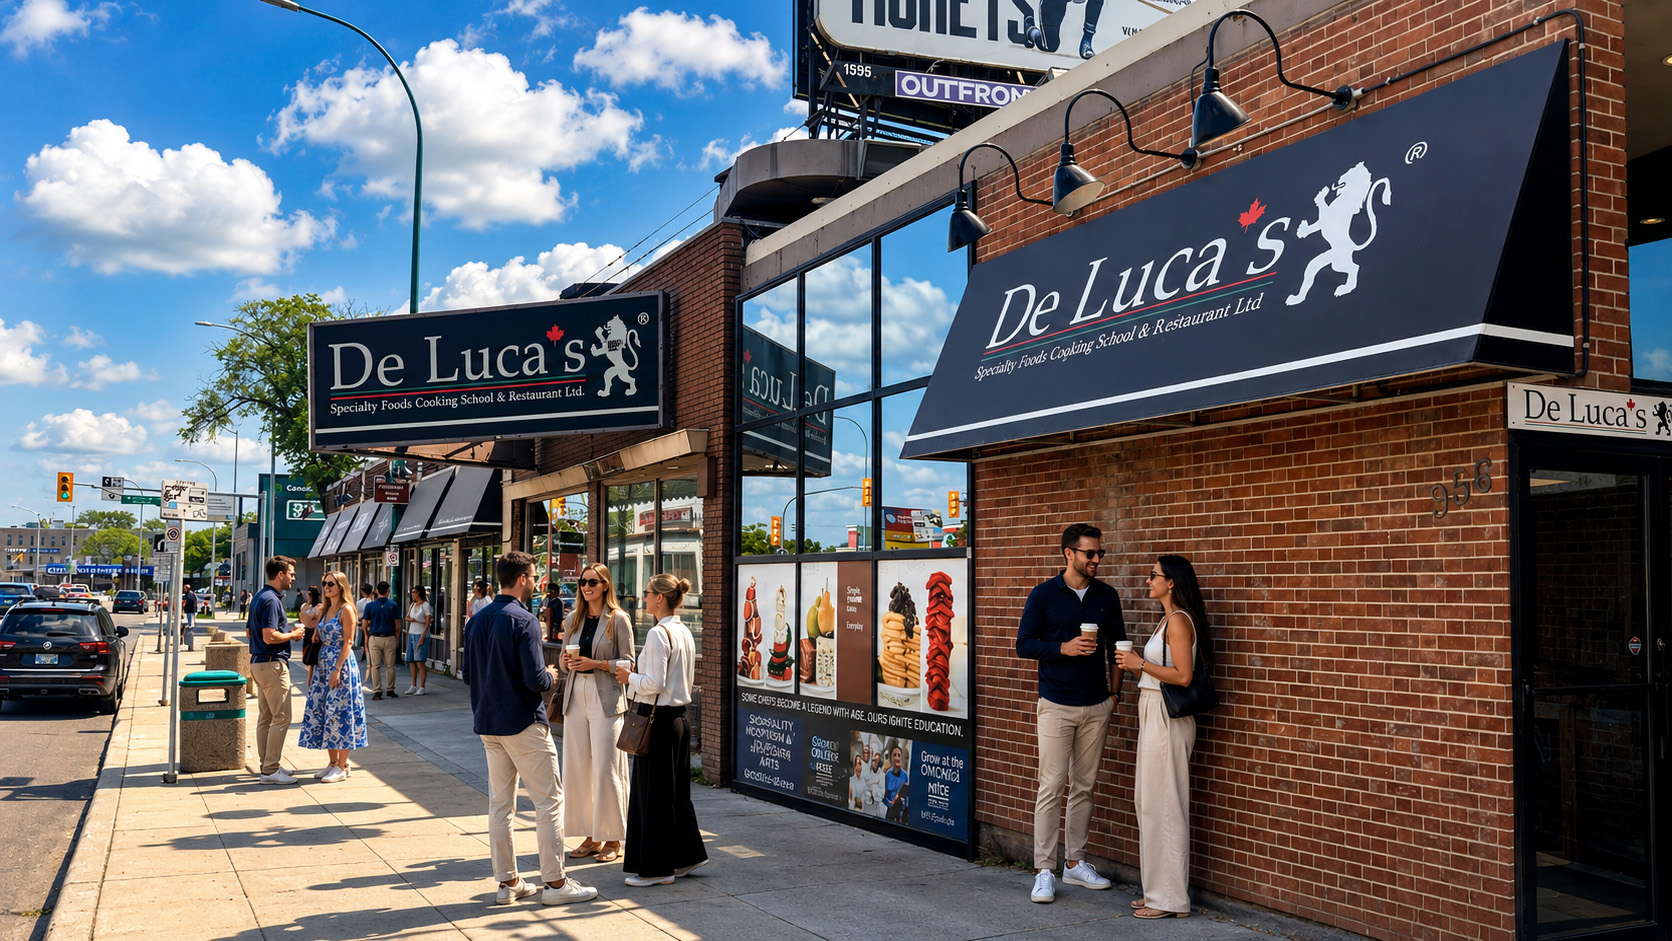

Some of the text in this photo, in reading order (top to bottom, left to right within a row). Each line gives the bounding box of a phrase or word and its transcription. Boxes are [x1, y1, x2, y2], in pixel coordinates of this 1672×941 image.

[974, 292, 1265, 382] Specialty Foods Cooking School & Restaurant Ltd
[985, 283, 1060, 350] De
[328, 342, 405, 390] De
[424, 324, 586, 383] Luca's
[330, 385, 586, 416] Specialty Foods Cooking School & Restaurant Ltd.
[1523, 388, 1647, 429] De Luca's
[1431, 457, 1493, 519] 956
[802, 702, 807, 712] A
[832, 706, 850, 719] WITH
[850, 709, 867, 721] AGE.
[867, 711, 888, 726] OURS
[914, 719, 964, 738] EDUCATION.
[920, 750, 941, 764] Grow
[941, 756, 950, 767] at
